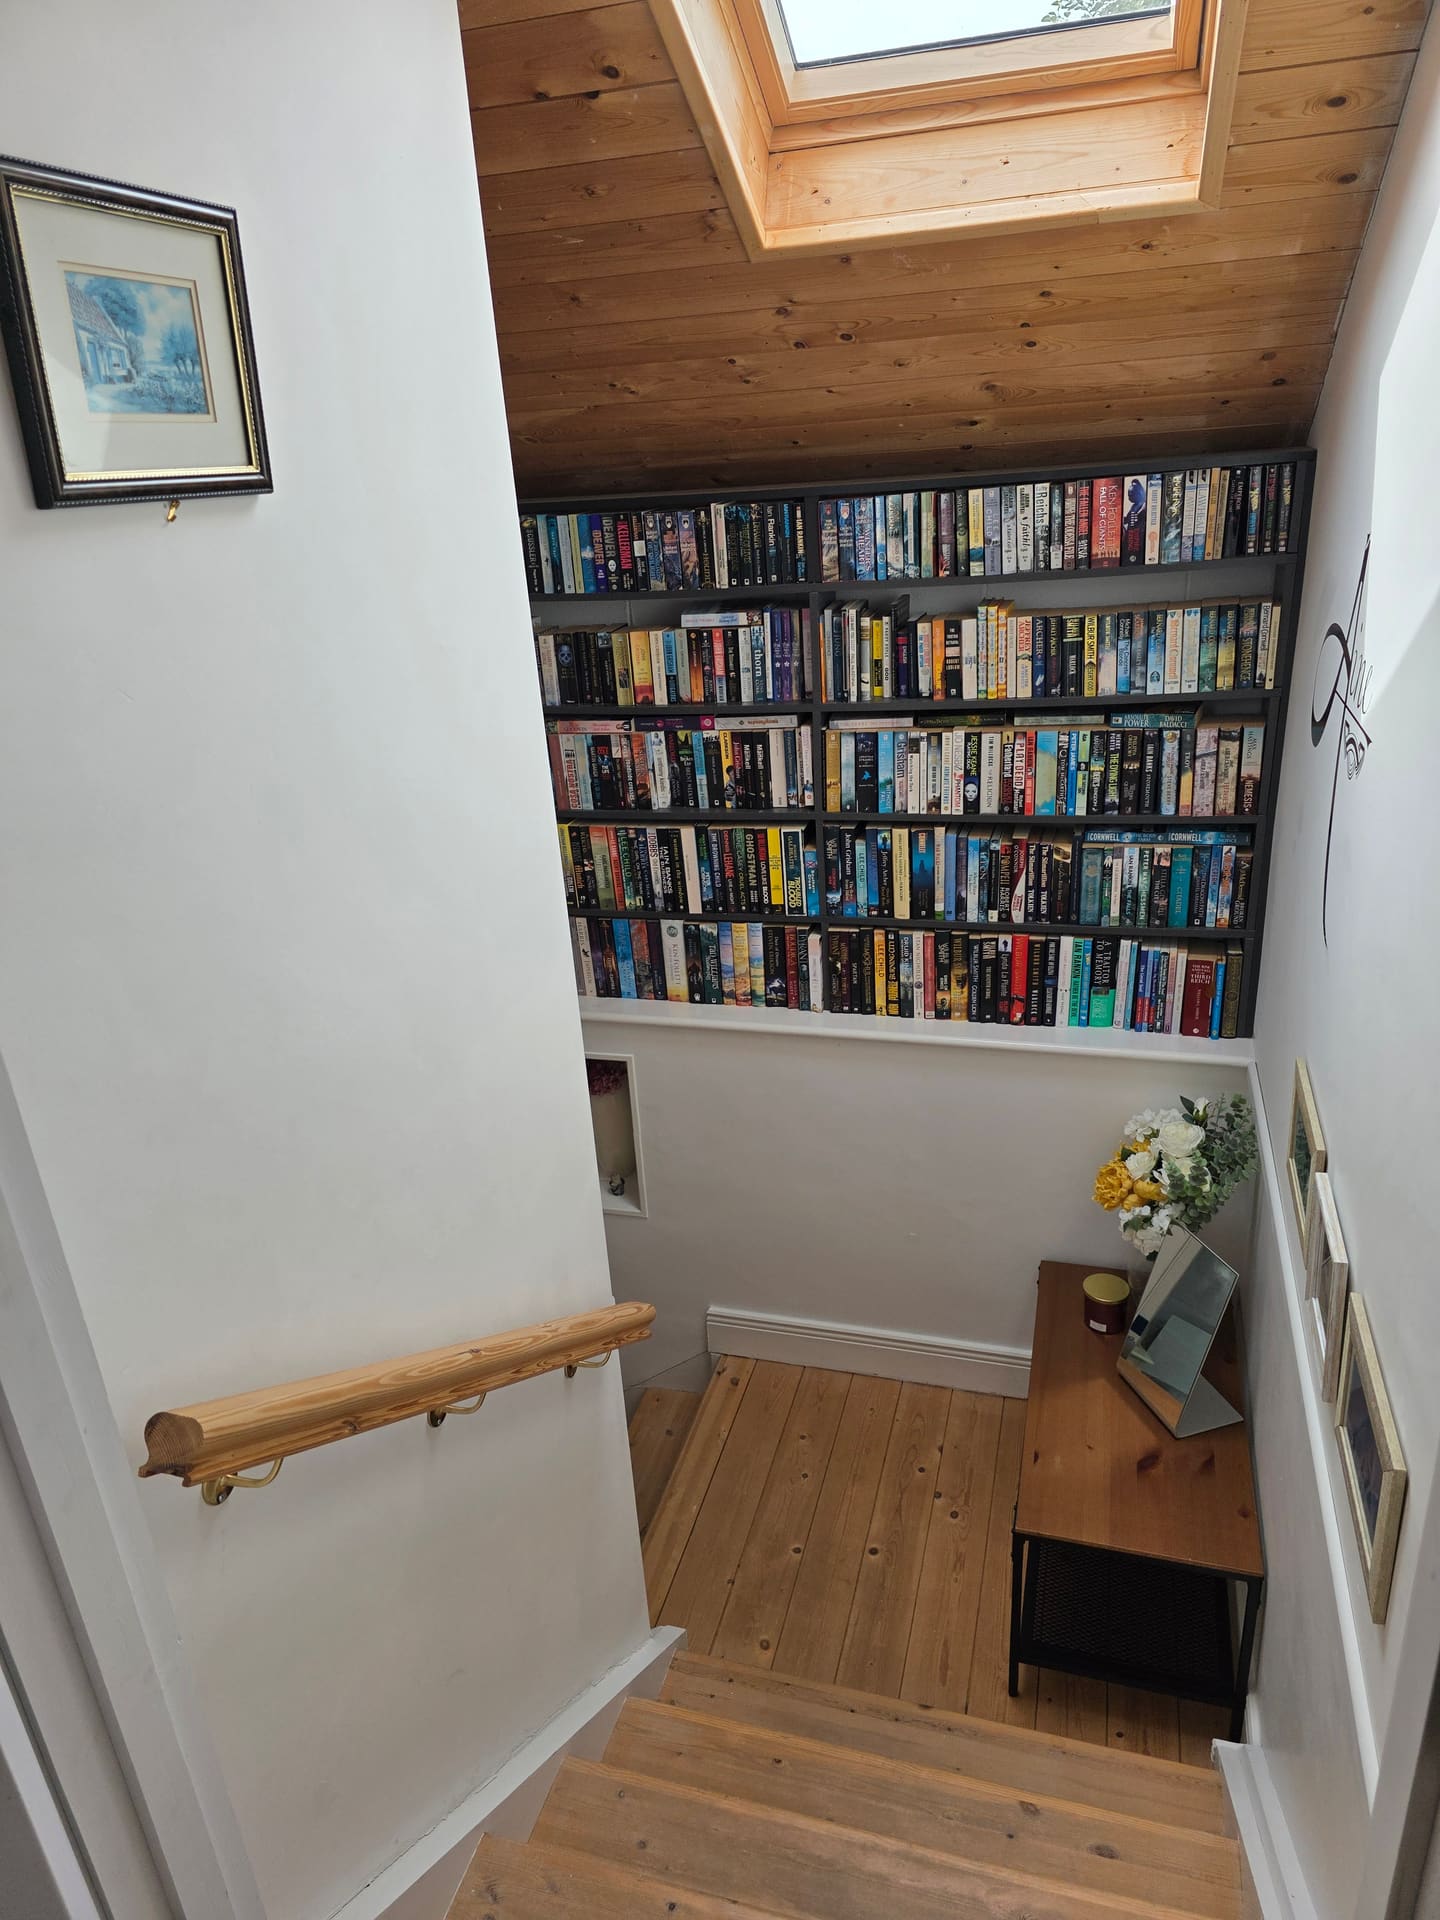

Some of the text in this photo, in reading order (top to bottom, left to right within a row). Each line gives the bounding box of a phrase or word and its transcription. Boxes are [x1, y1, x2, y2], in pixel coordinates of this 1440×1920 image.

[1035, 491, 1048, 525] Reichs
[1098, 487, 1107, 551] FALL OF GIANTS
[603, 519, 616, 557] DEAVER
[617, 524, 632, 569] KELLERMAN
[767, 518, 777, 547] Rankin
[796, 531, 805, 554] RANKIN
[1017, 621, 1025, 653] ARCHER
[1023, 619, 1032, 653] JEFFREY
[1035, 618, 1043, 656] ARCHER
[1086, 616, 1096, 660] WILBUR SMITH
[1118, 618, 1126, 640] Connelly
[754, 649, 764, 677] thorn
[1239, 637, 1253, 683] STONEHENGE
[1123, 719, 1150, 728] POWER
[1160, 720, 1188, 729] BALDACCI
[723, 732, 731, 760] CLARKSON
[969, 735, 978, 777] JESSIE KEANE
[1015, 743, 1025, 764] PLAY
[1109, 733, 1117, 752] PORTER
[896, 741, 907, 779] Grisham
[1003, 744, 1014, 778] Fatherland
[1110, 753, 1120, 765] THE
[1144, 755, 1154, 773] BANKS
[625, 759, 636, 801] roadside crosses
[953, 779, 962, 808] PHANTOM
[1242, 779, 1254, 808] NEMESIS
[648, 835, 659, 858] DOBBS
[1028, 844, 1036, 855] The
[1041, 846, 1049, 856] The
[1089, 832, 1120, 842] CORNWELL
[1171, 832, 1203, 843] CORNWELL
[622, 853, 633, 878] CHILD
[723, 853, 735, 879] LEHANE
[745, 833, 758, 886] GHOSTMAN
[844, 832, 853, 876] John Grisham
[1142, 850, 1150, 869] PETER
[663, 846, 674, 894] IAIN BANKS
[1000, 854, 1011, 885] POMPEII
[1126, 864, 1134, 885] RANKIN
[739, 891, 747, 905] ACTS
[787, 880, 797, 908] BLOOD
[794, 876, 803, 907] TROUBLED
[1027, 889, 1035, 913] TOLKIEN
[1040, 890, 1048, 914] TOLKIEN
[1232, 900, 1241, 925] GROUND
[877, 944, 885, 978] LEE CHILD
[972, 944, 980, 983] WILBUR SMITH
[1000, 953, 1010, 970] Lynda
[1072, 941, 1083, 979] IAN RANKIN
[1093, 940, 1105, 986] TO MEMORY
[1101, 951, 1112, 984] TRAITOR
[1000, 978, 1010, 998] Plante
[1030, 989, 1039, 1015] WARLOCK
